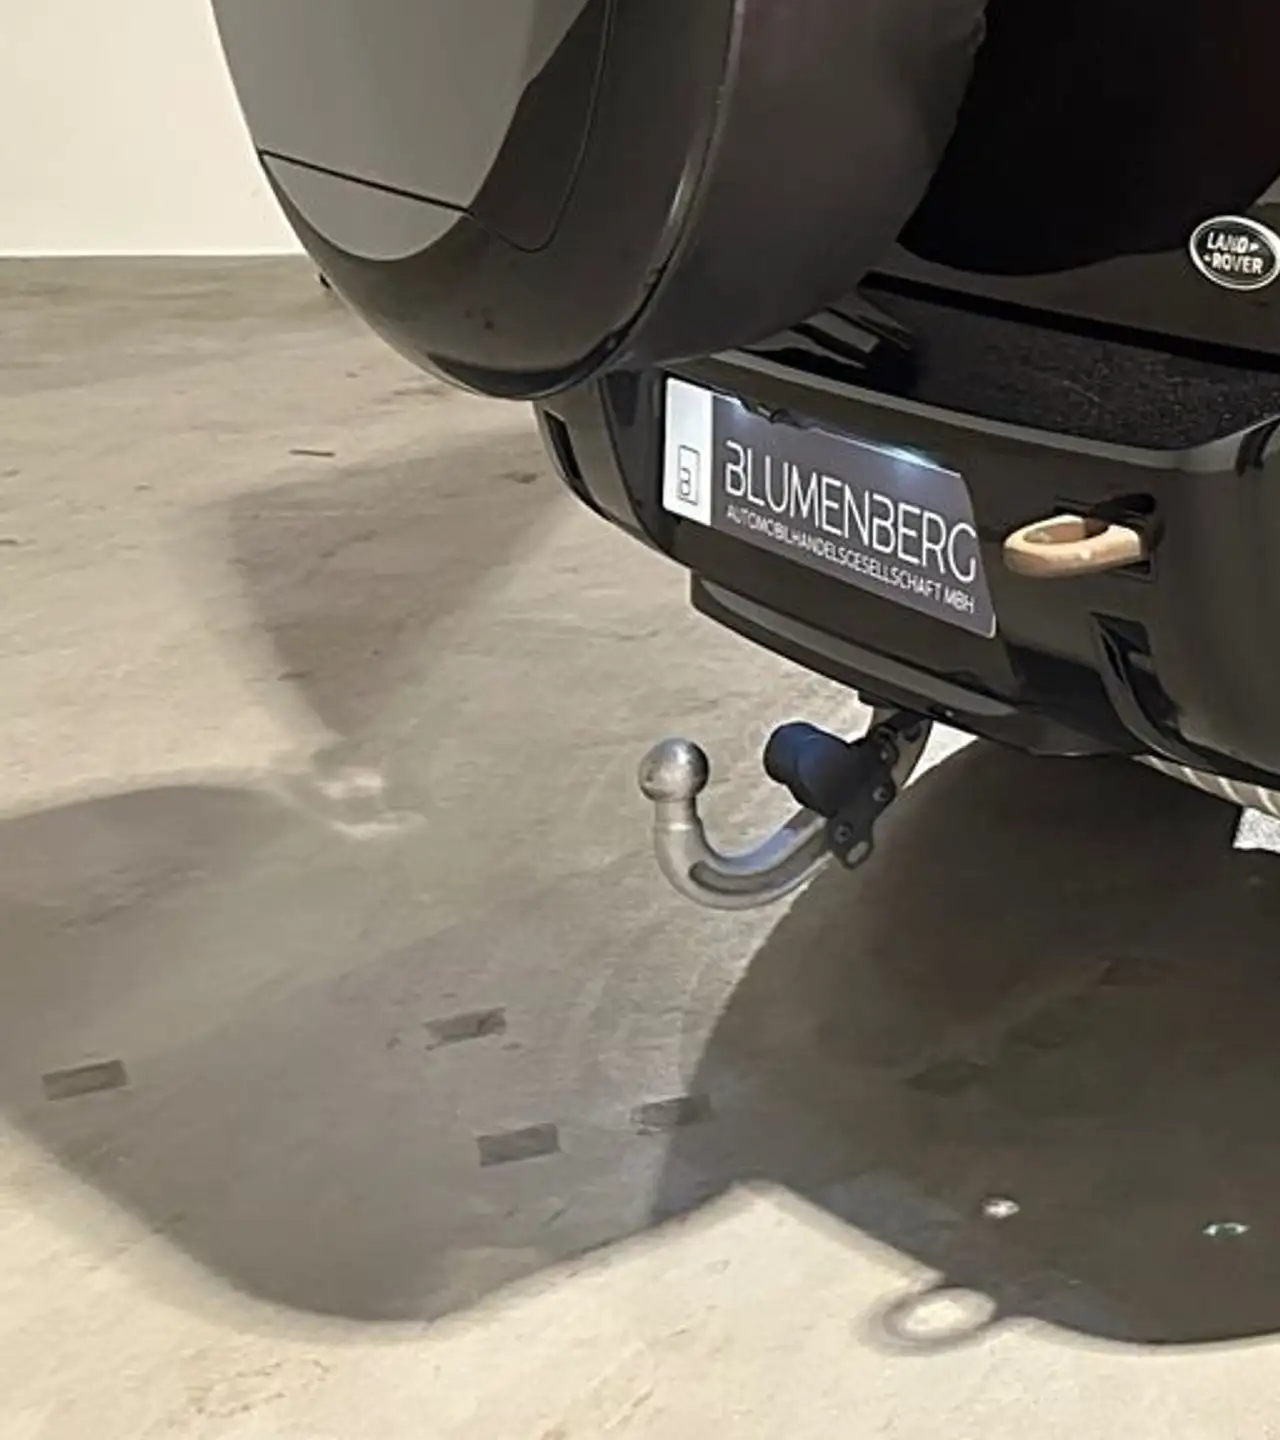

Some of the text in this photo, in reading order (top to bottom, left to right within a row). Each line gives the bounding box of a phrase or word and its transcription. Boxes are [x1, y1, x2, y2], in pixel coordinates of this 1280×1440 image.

[1206, 231, 1249, 254] LAND
[1211, 251, 1264, 275] ROVER
[724, 439, 978, 584] BLUMENBERG
